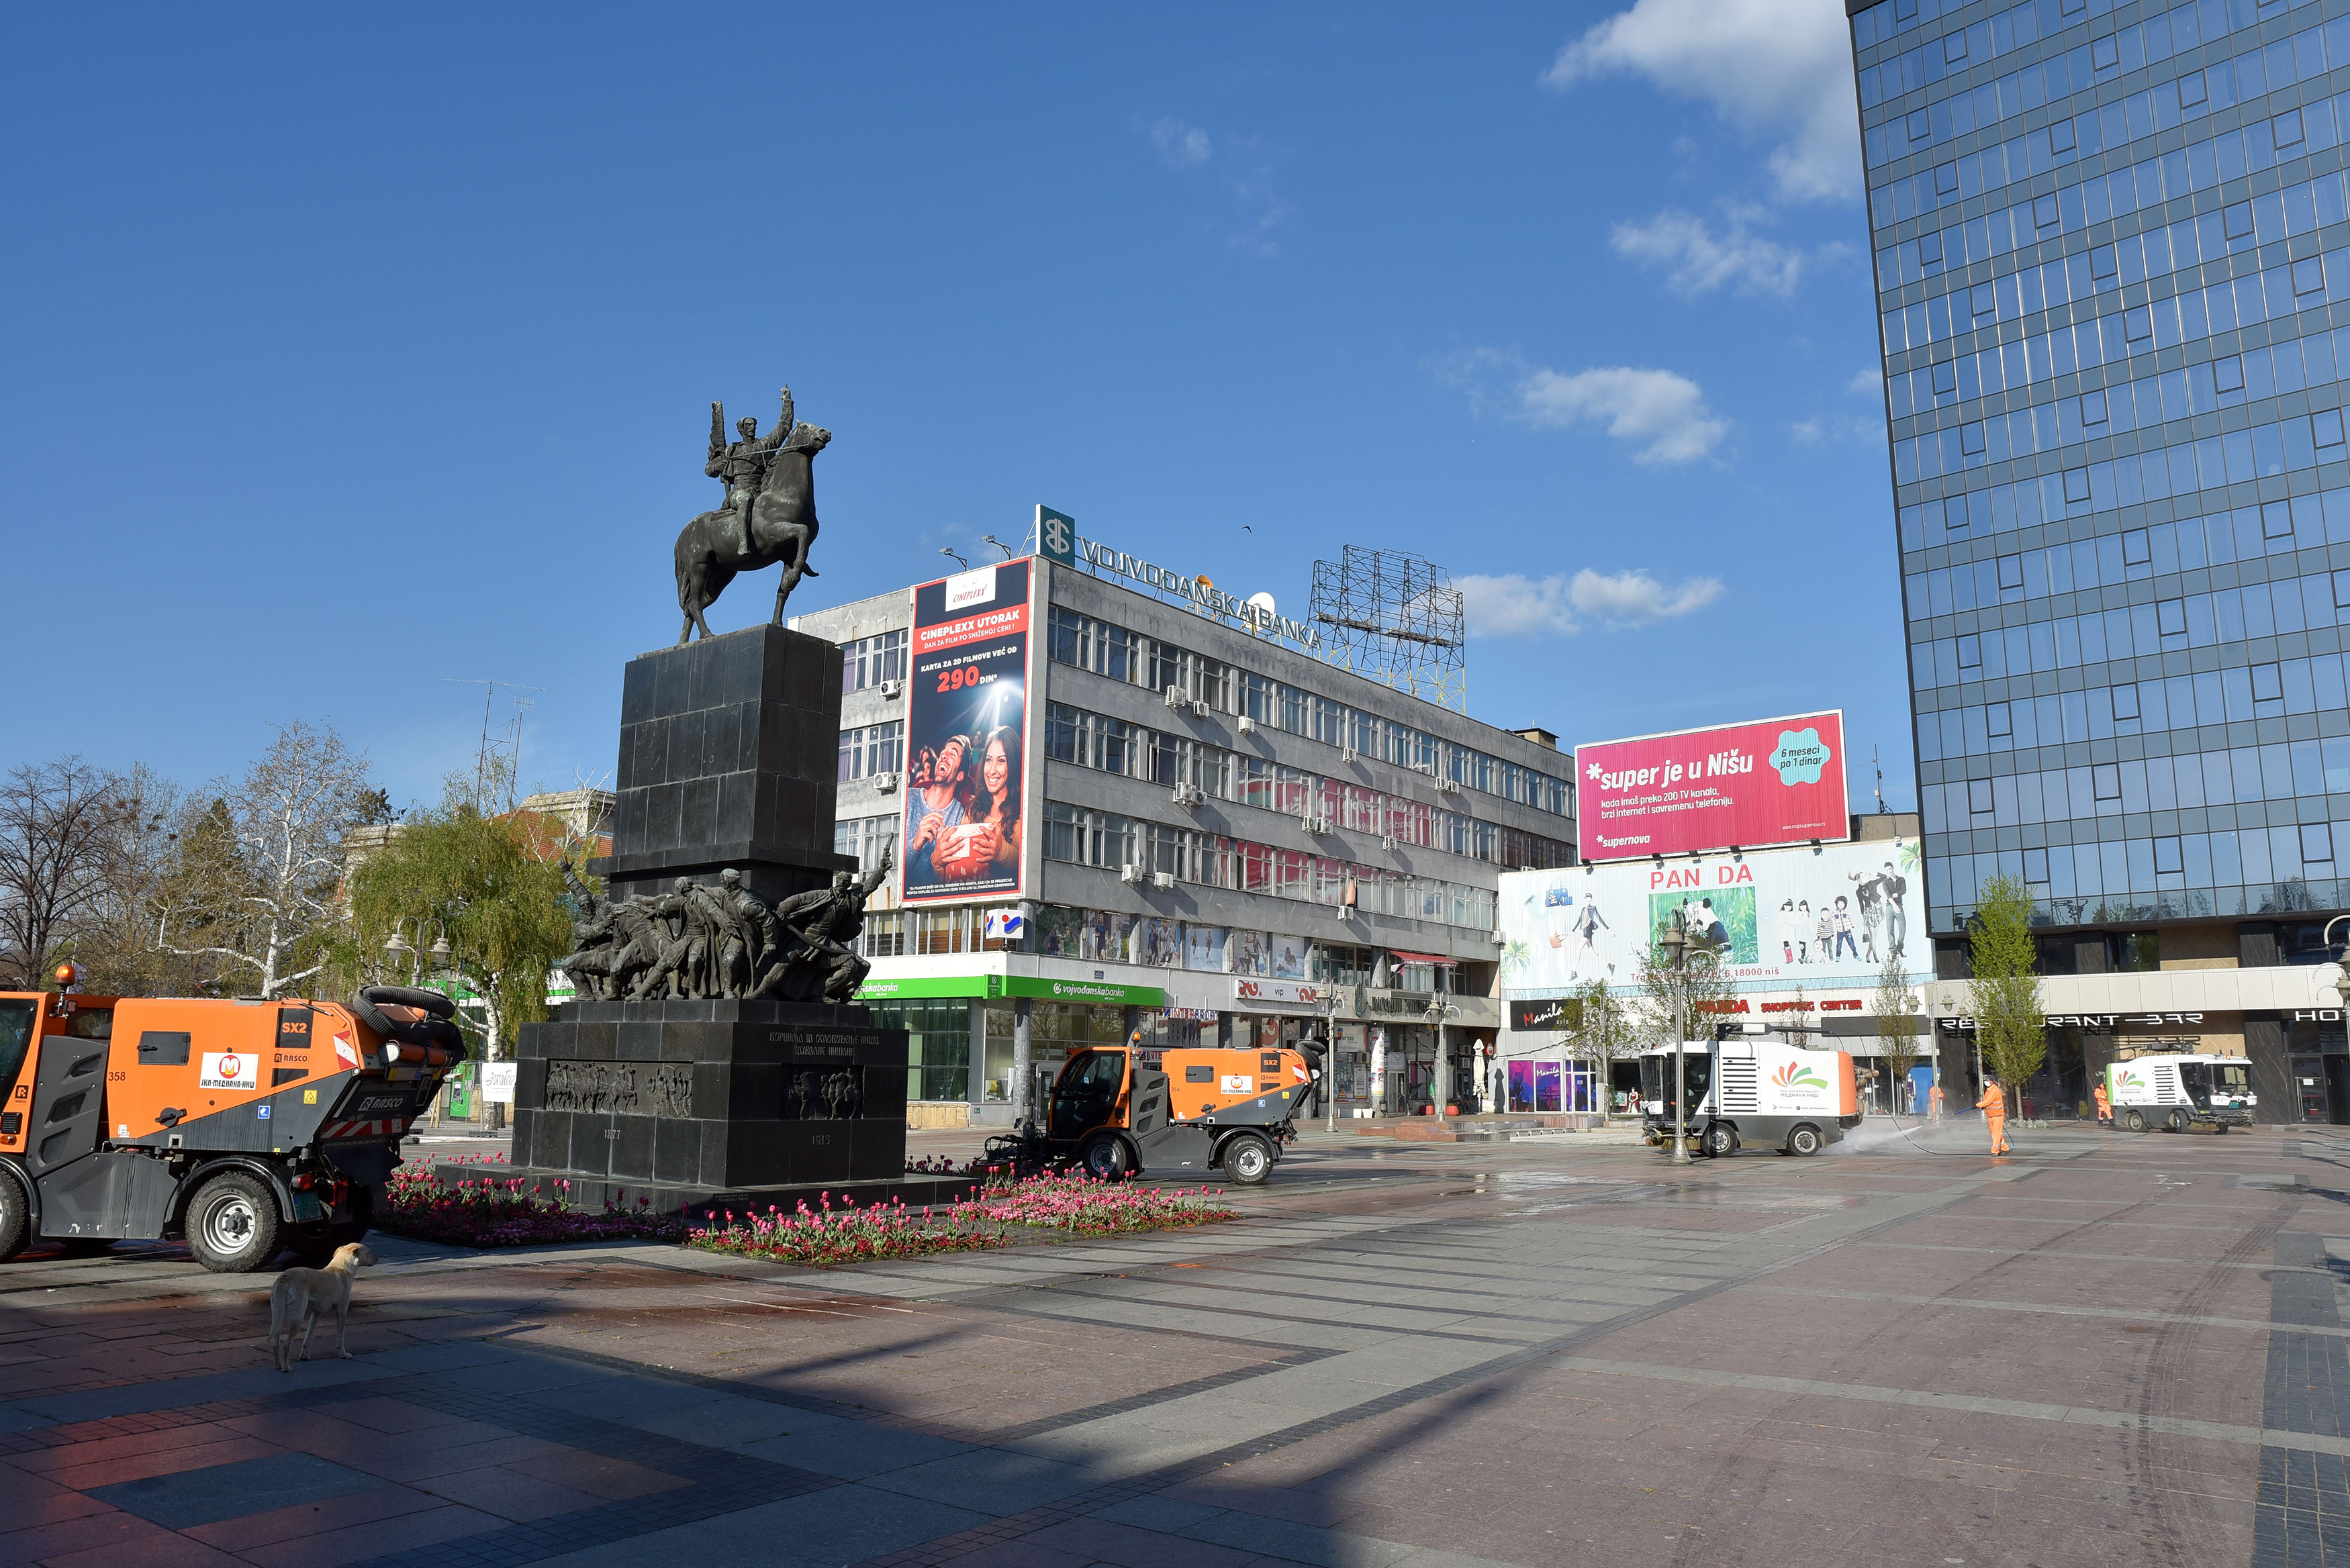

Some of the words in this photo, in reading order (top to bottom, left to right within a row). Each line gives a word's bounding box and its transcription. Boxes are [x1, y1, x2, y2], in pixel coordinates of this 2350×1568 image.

[953, 584, 988, 603] CINEPLEXX
[1080, 536, 1252, 621] VOJVOĐANSKA
[1258, 607, 1322, 650] BANKA
[921, 620, 975, 641] CINEPLEXX
[977, 609, 1020, 629] UTORAK
[925, 640, 936, 649] DAN
[945, 636, 958, 644] FILM
[968, 627, 996, 640] SNIŽENOJ
[997, 624, 1011, 633] CENI
[921, 662, 942, 673] KARTA
[943, 658, 952, 668] ZA
[953, 657, 961, 666] 2D
[962, 650, 991, 664] FILMOVE
[992, 646, 1006, 658] VEĆ
[1006, 646, 1017, 654] OD
[937, 665, 980, 693] 290
[1781, 748, 1787, 758] 6
[1788, 744, 1820, 757] meseci
[1601, 767, 1660, 792] super
[1661, 759, 1683, 788] je
[1688, 761, 1701, 779] u
[1707, 748, 1753, 777] Nišu
[1780, 760, 1791, 770] po
[1793, 758, 1797, 767] 1
[1799, 756, 1822, 767] dinar
[1601, 799, 1619, 808] kada
[1621, 795, 1639, 806] imaš
[1640, 795, 1662, 806] preko
[1663, 791, 1678, 801] 200
[1679, 790, 1689, 799] TV
[1691, 787, 1720, 797] kanala,
[1601, 810, 1615, 819] brzi
[1616, 806, 1646, 818] internet
[1647, 805, 1650, 814] i
[1651, 801, 1694, 814] savremenu
[1695, 797, 1734, 808] telefoniju.
[1602, 835, 1650, 848] supernova
[1650, 868, 1700, 889] PAN
[1718, 864, 1753, 884] DA
[1631, 973, 1646, 983] Trg
[1765, 967, 1780, 975] niš
[1063, 985, 1125, 997] vojvođanskabanka
[1274, 987, 1284, 998] vip
[1820, 999, 1863, 1011] CENTER
[1170, 1008, 1219, 1021] INTERSPORT
[1523, 1002, 1564, 1027] Manila
[2295, 1010, 2346, 1021] HO
[282, 1022, 308, 1033] SX2
[1146, 1050, 1162, 1060] INTE
[108, 1071, 126, 1081] 358
[1536, 1066, 1560, 1077] Manila
[371, 1097, 403, 1108] RASCO
[604, 1129, 621, 1140] 1877
[812, 1134, 831, 1145] 1915
